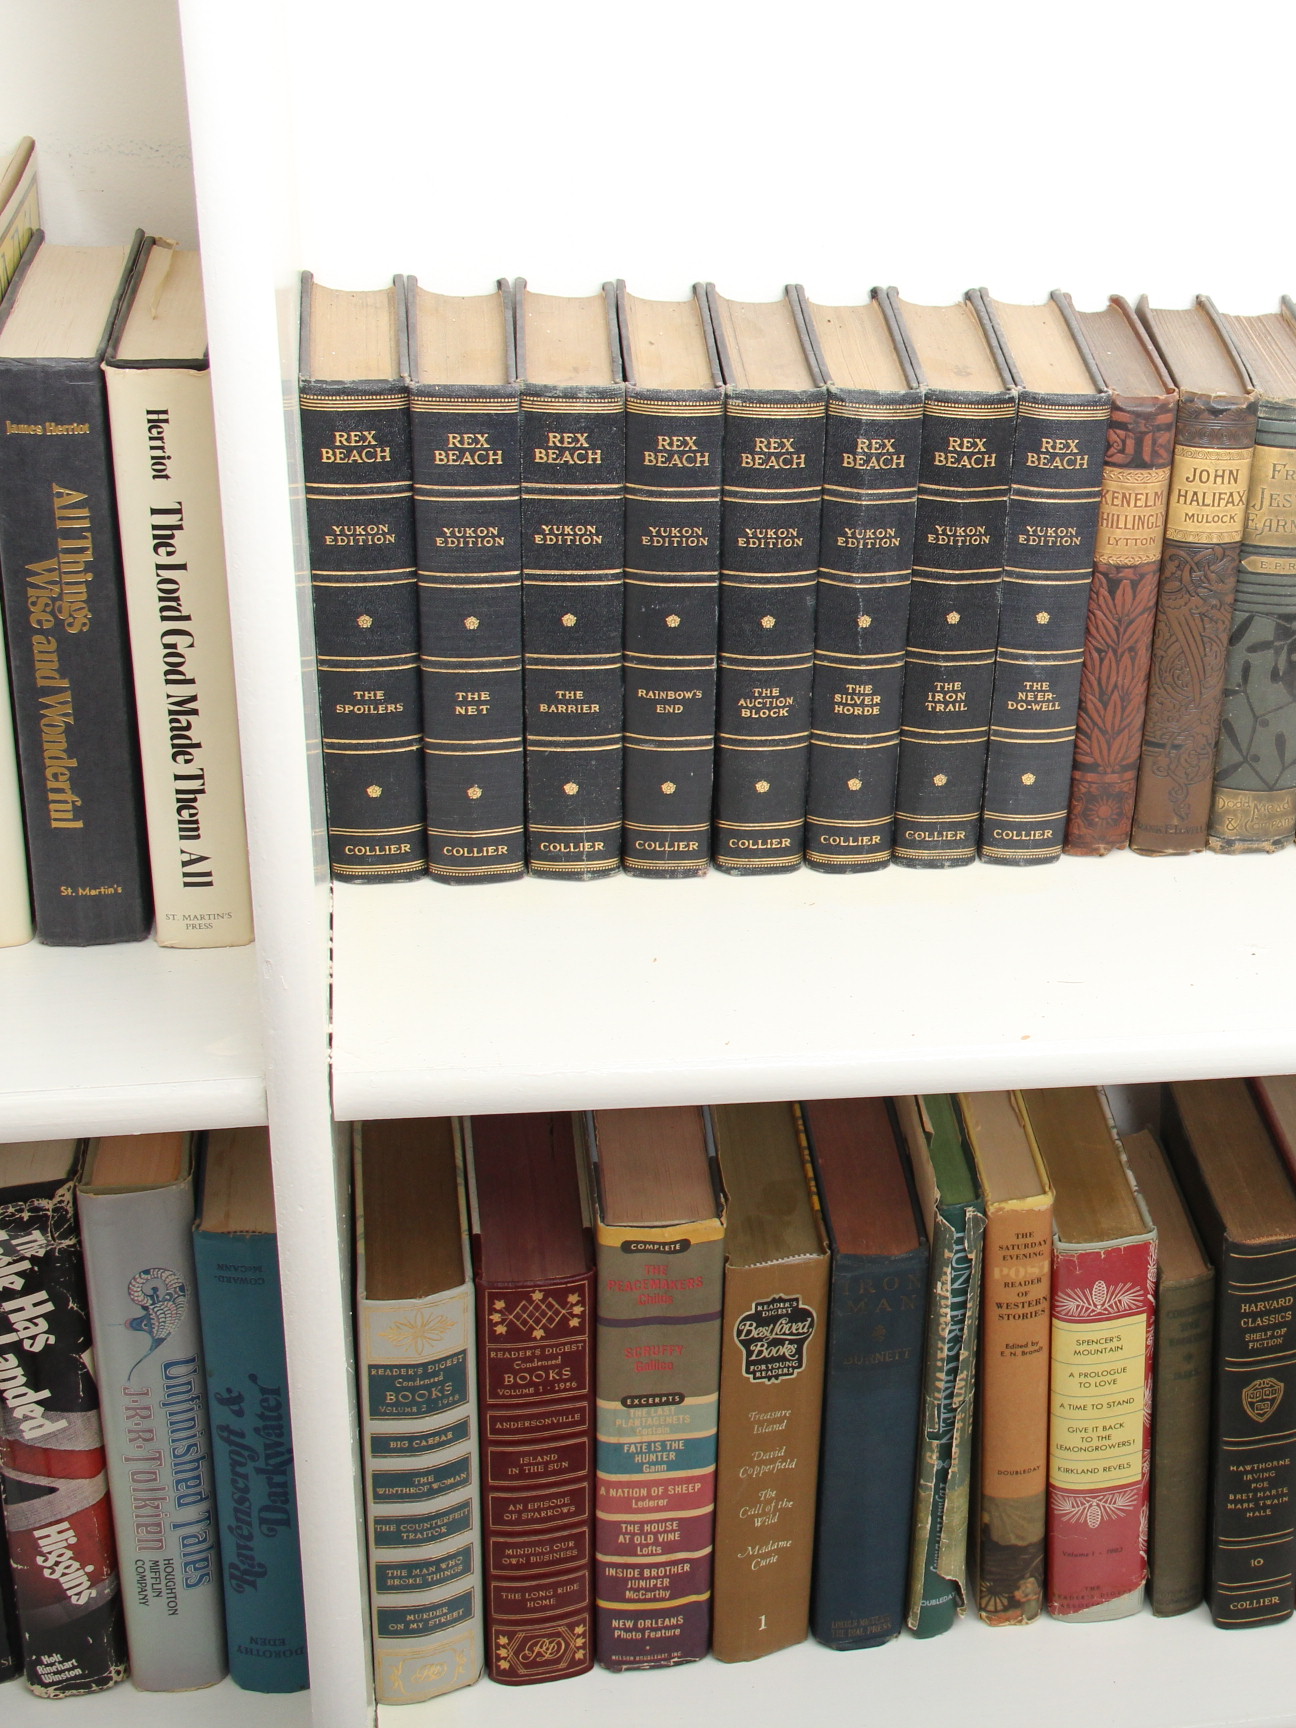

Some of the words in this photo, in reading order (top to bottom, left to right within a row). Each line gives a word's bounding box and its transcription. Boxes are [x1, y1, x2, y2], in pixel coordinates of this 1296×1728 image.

[6, 420, 43, 435] James
[46, 421, 90, 435] Herriot
[145, 408, 169, 481] Herriot
[334, 431, 378, 446] REX
[448, 434, 489, 448] REX
[548, 433, 589, 447] REX
[657, 436, 698, 451] REX
[755, 438, 794, 452] REX
[948, 437, 987, 451] REX
[857, 439, 896, 453] REX
[1041, 439, 1079, 453] REX
[321, 448, 390, 463] BEACH
[434, 451, 502, 465] BEACH
[534, 450, 601, 464] BEACH
[643, 452, 709, 467] BEACH
[742, 454, 805, 468] BEACH
[843, 454, 905, 469] BEACH
[934, 452, 996, 468] BEACH
[1027, 453, 1088, 469] BEACH
[1186, 468, 1239, 484] JOHN
[1177, 489, 1246, 507] HALIFAX
[53, 483, 88, 529] All
[1184, 513, 1237, 524] MULOCK
[149, 502, 183, 557] The
[1107, 536, 1156, 546] LYTTON
[55, 532, 95, 635] Things
[25, 559, 59, 630] Wise
[154, 561, 191, 622] Lord
[33, 637, 68, 688] and
[160, 628, 195, 684] God
[753, 688, 780, 697] THE
[846, 684, 872, 694] THE
[934, 682, 961, 691] THE
[1024, 682, 1049, 691] THE
[353, 690, 384, 701] THE
[456, 691, 490, 701] THE
[555, 690, 583, 700] THE
[637, 689, 702, 699] RAINBOW'S
[835, 694, 881, 704] SILVER
[928, 692, 966, 701] IRON
[1017, 690, 1056, 700] NE'ER-
[336, 703, 404, 714] SPOILERS
[540, 703, 599, 714] BARRIER
[656, 704, 683, 714] END
[738, 697, 793, 708] AUCTION
[925, 702, 967, 712] TRAIL
[1008, 700, 1060, 711] DO-WELL
[455, 705, 490, 715] NET
[741, 708, 789, 718] BLOCK
[834, 705, 880, 715] HORDE
[166, 694, 200, 764] Made
[37, 691, 83, 829] Wonderful
[173, 768, 206, 840] Them
[180, 848, 213, 888] All
[60, 886, 74, 896] St.
[78, 885, 122, 897] Martin's
[183, 912, 232, 922] MARTIN'S
[186, 921, 213, 930] PRESS
[631, 1243, 681, 1251] COMPLETE
[1241, 1296, 1293, 1313] HARVARD
[1241, 1312, 1292, 1328] CLASSICS
[1076, 1335, 1121, 1346] SPENCER'S
[490, 1349, 541, 1359] READER'S
[545, 1342, 584, 1354] DIGEST
[749, 1341, 798, 1360] Books
[1074, 1345, 1123, 1356] MOUNTAIN
[513, 1356, 562, 1369] Condensed
[504, 1368, 572, 1386] BOOKS
[1079, 1367, 1127, 1378] PROLOGUE
[1094, 1379, 1117, 1387] LOVE
[215, 1387, 244, 1418] &
[627, 1396, 680, 1405] EXCERPTS
[496, 1414, 581, 1429] ANDERSONVILLE
[161, 1356, 210, 1512] Unfinished
[248, 1373, 293, 1539] Darkwater
[1058, 1465, 1099, 1475] KIRKLAND
[1102, 1461, 1131, 1473] REVELS
[1230, 1458, 1291, 1472] HAWTHORNE
[217, 1424, 267, 1594] Ravenscroft
[171, 1506, 214, 1590] Tales
[34, 1522, 98, 1606] Higgins
[1251, 1558, 1263, 1567] 10
[606, 1567, 640, 1577] INSIDE
[644, 1564, 690, 1576] BROTHER
[134, 1559, 149, 1606] COMPANY
[149, 1560, 162, 1597] MIFFLIN
[627, 1578, 670, 1588] JUNIPER
[163, 1558, 177, 1616] HOUGHTON
[626, 1590, 670, 1599] McCarthy
[1230, 1597, 1280, 1610] COLLIER
[612, 1619, 634, 1628] NEW
[638, 1616, 683, 1628] ORLEANS
[759, 1615, 768, 1630] 1
[615, 1629, 641, 1639] Photo
[645, 1628, 680, 1637] Feature
